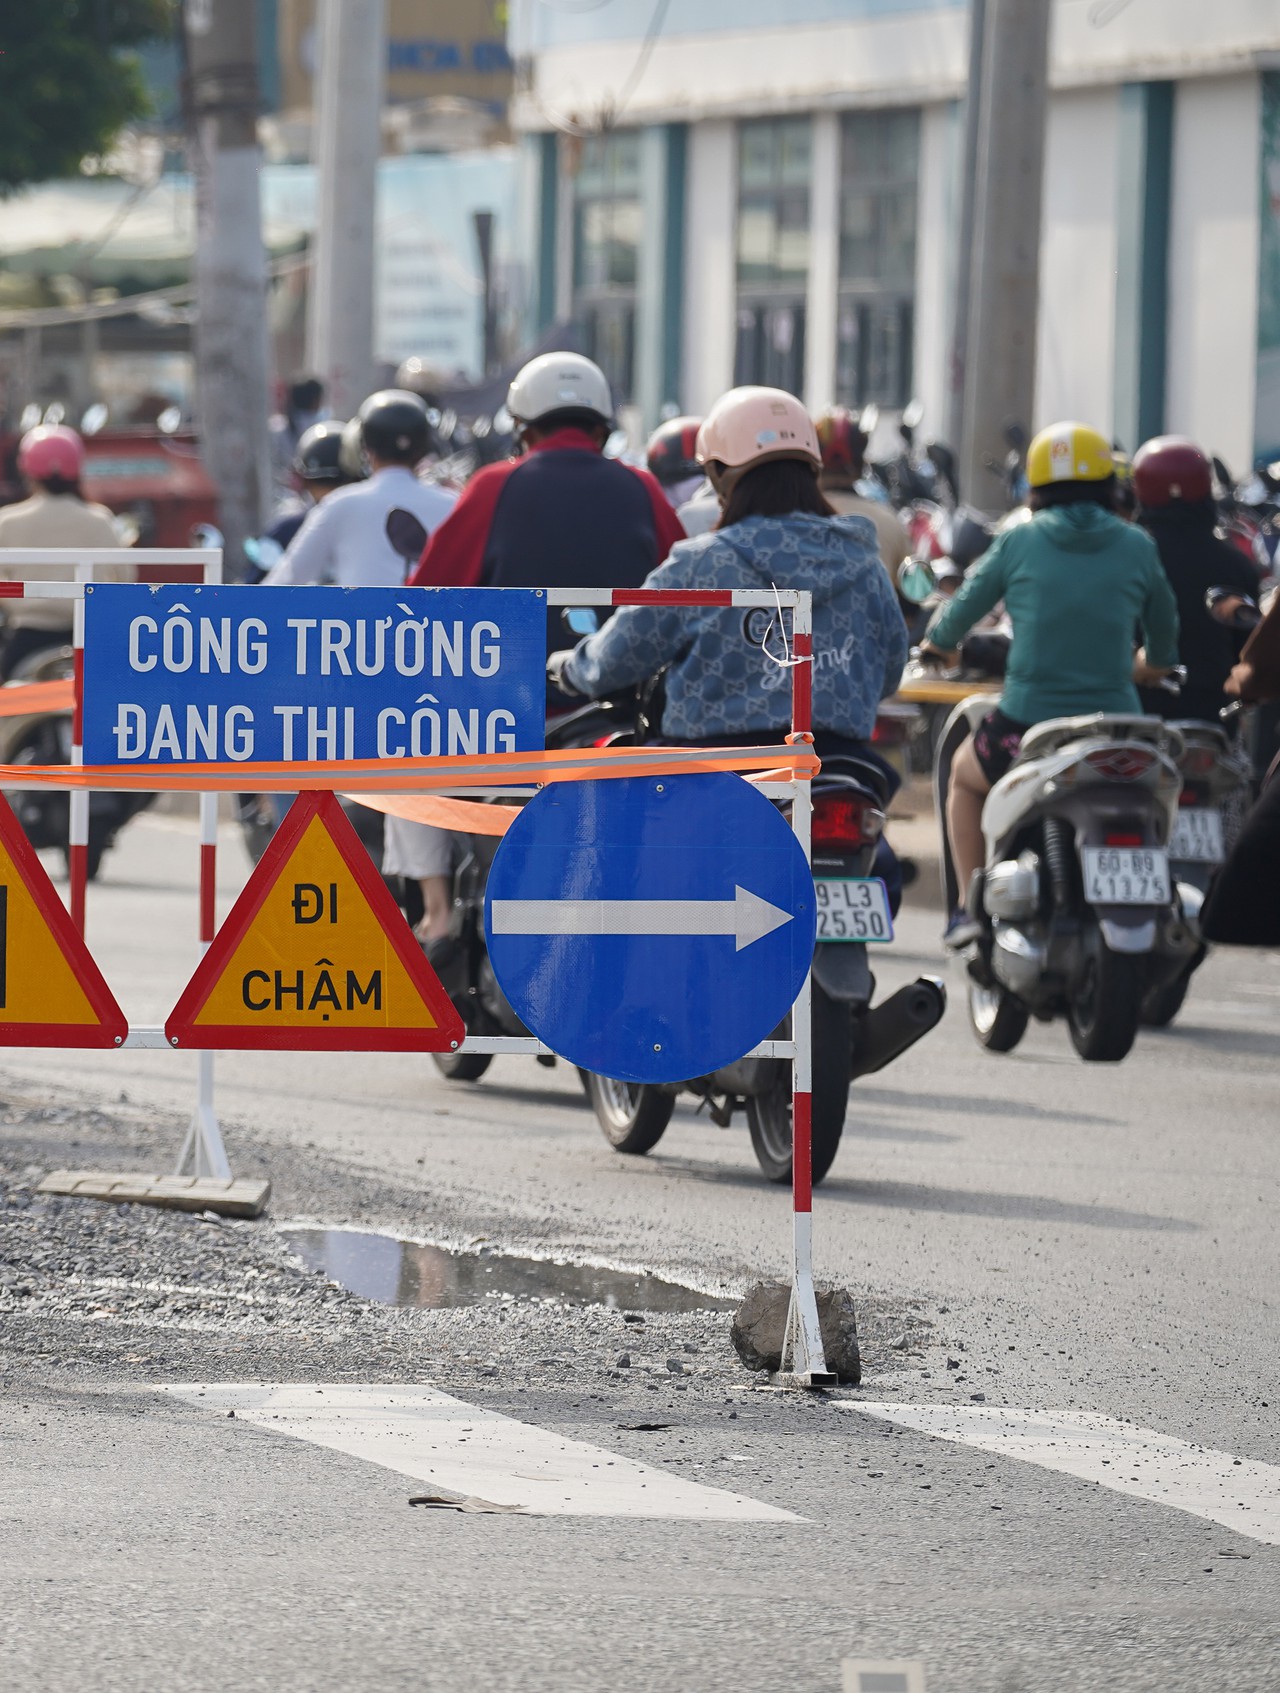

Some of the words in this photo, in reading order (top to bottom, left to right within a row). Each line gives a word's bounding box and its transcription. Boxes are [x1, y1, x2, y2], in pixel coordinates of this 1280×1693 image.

[129, 603, 268, 675] CÔNG
[287, 603, 501, 677] TRƯỜNG
[112, 703, 255, 762] ĐANG
[273, 706, 355, 762] THI
[377, 693, 516, 760] CÔNG
[291, 883, 338, 924] ĐI
[242, 958, 382, 1021] CHẬM
